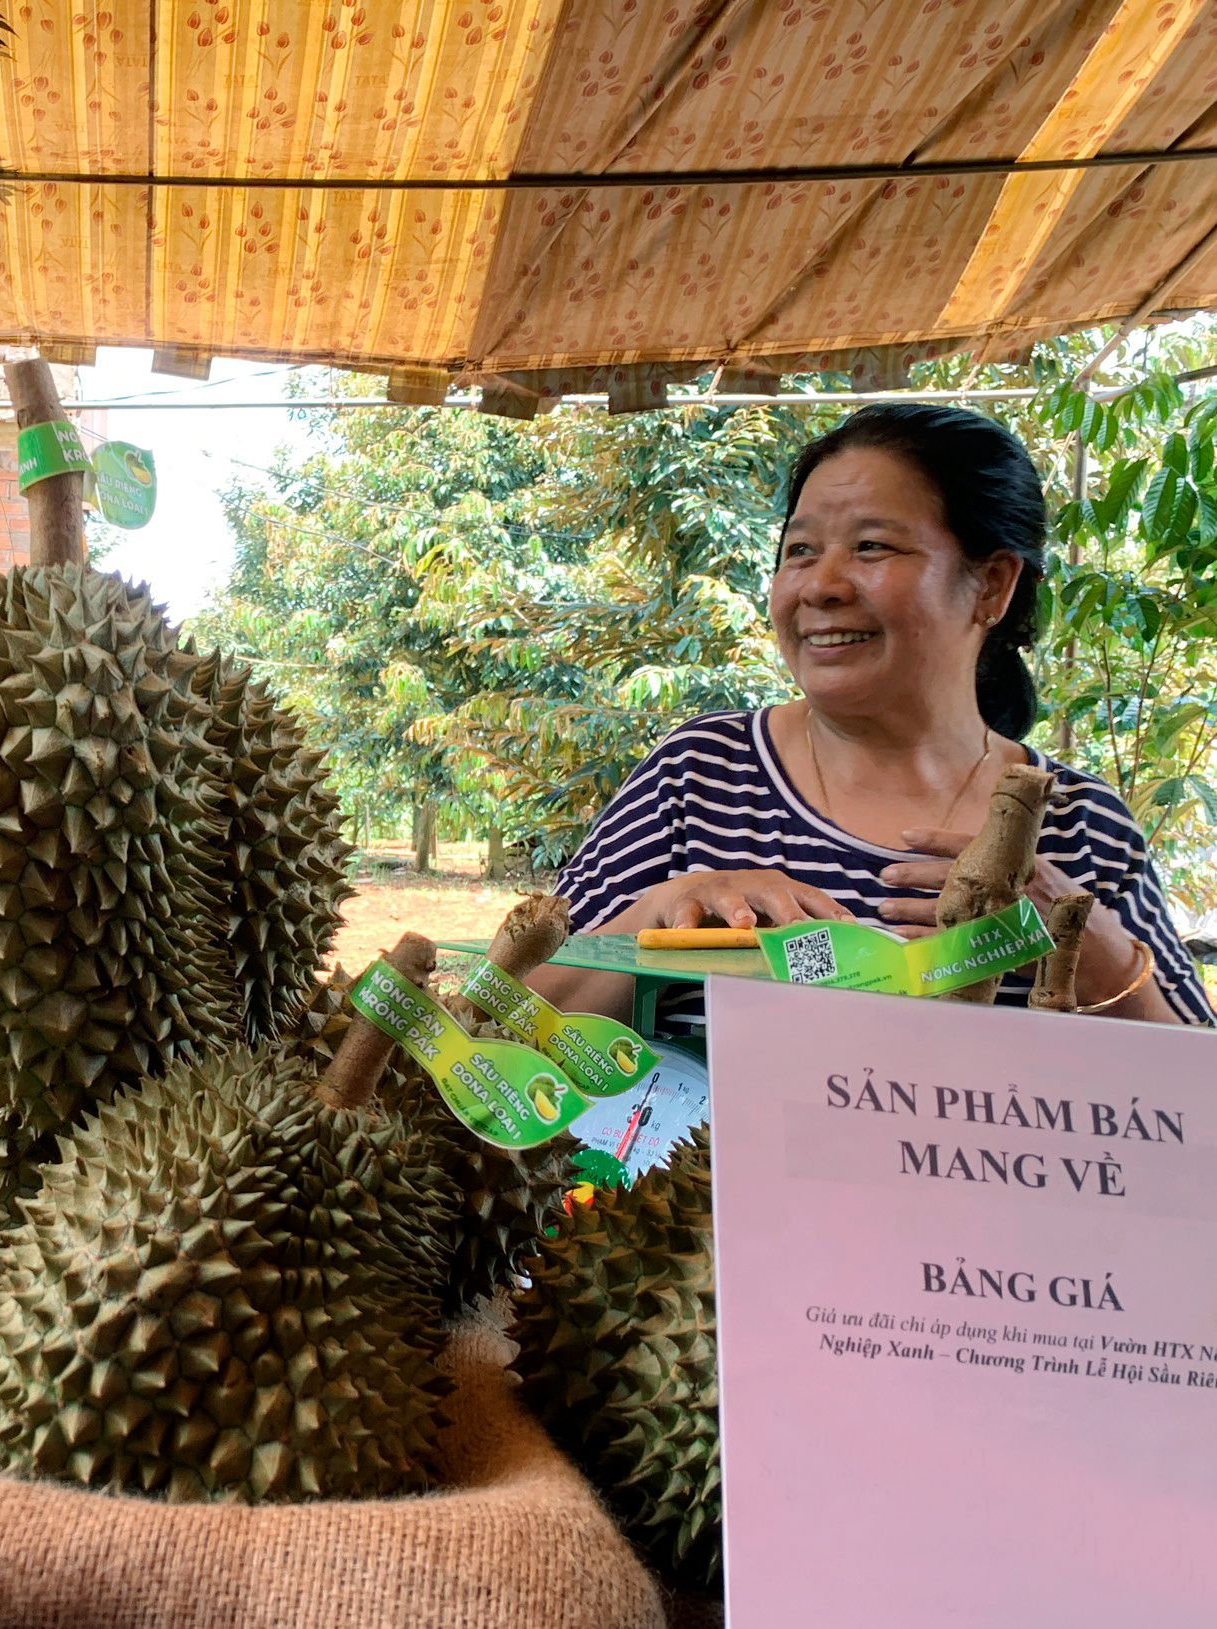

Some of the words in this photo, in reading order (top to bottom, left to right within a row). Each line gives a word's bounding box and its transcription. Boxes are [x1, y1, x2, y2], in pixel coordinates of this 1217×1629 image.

[920, 962, 962, 983] NÔNG
[964, 939, 1026, 970] NGHIỆP
[1027, 928, 1046, 945] XA
[969, 928, 1002, 948] HTX
[370, 969, 415, 1011] NÔNG
[413, 1006, 446, 1037] SẢN
[465, 978, 508, 1014] KRÔNG
[474, 965, 511, 995] NÔNG
[510, 992, 539, 1016] SẢN
[358, 986, 409, 1031] KRÔNG
[406, 1026, 440, 1061] PẮK
[548, 1033, 580, 1065] DONA
[579, 1061, 604, 1086] LOẠI
[583, 1044, 614, 1076] RIÊNG
[652, 1072, 660, 1083] 0
[450, 1061, 490, 1104] DONA
[487, 1099, 517, 1134] LOẠI
[495, 1079, 530, 1121] RIÊNG
[677, 1082, 684, 1092] 1
[699, 1095, 707, 1105] 2
[827, 1067, 918, 1117] SẢN
[932, 1084, 1077, 1134] PHẨM
[1087, 1096, 1185, 1144] BÁN
[651, 1121, 661, 1131] kg
[897, 1140, 1049, 1188] MANG
[1059, 1151, 1126, 1197] VỀ
[920, 1257, 1037, 1303] BẢNG
[1048, 1272, 1125, 1311] GIÁ
[806, 1305, 836, 1324] Giá
[842, 1312, 863, 1327] ưu
[868, 1312, 896, 1330] đãi
[930, 1318, 951, 1339] áp
[956, 1321, 998, 1344] dụng
[1002, 1325, 1028, 1343] khi
[1032, 1332, 1068, 1348] mua
[1073, 1335, 1095, 1352] tại
[1101, 1335, 1147, 1355] Vườn
[1153, 1340, 1194, 1360] HTX
[819, 1333, 882, 1360] Nghiệp
[887, 1340, 934, 1360] Xanh
[956, 1347, 1025, 1374] Chương
[1032, 1355, 1079, 1375] Trình
[1085, 1357, 1107, 1378] Lễ
[1112, 1362, 1143, 1384] Hội
[1148, 1363, 1180, 1385] Sầu
[1187, 1371, 1217, 1389] Riê
